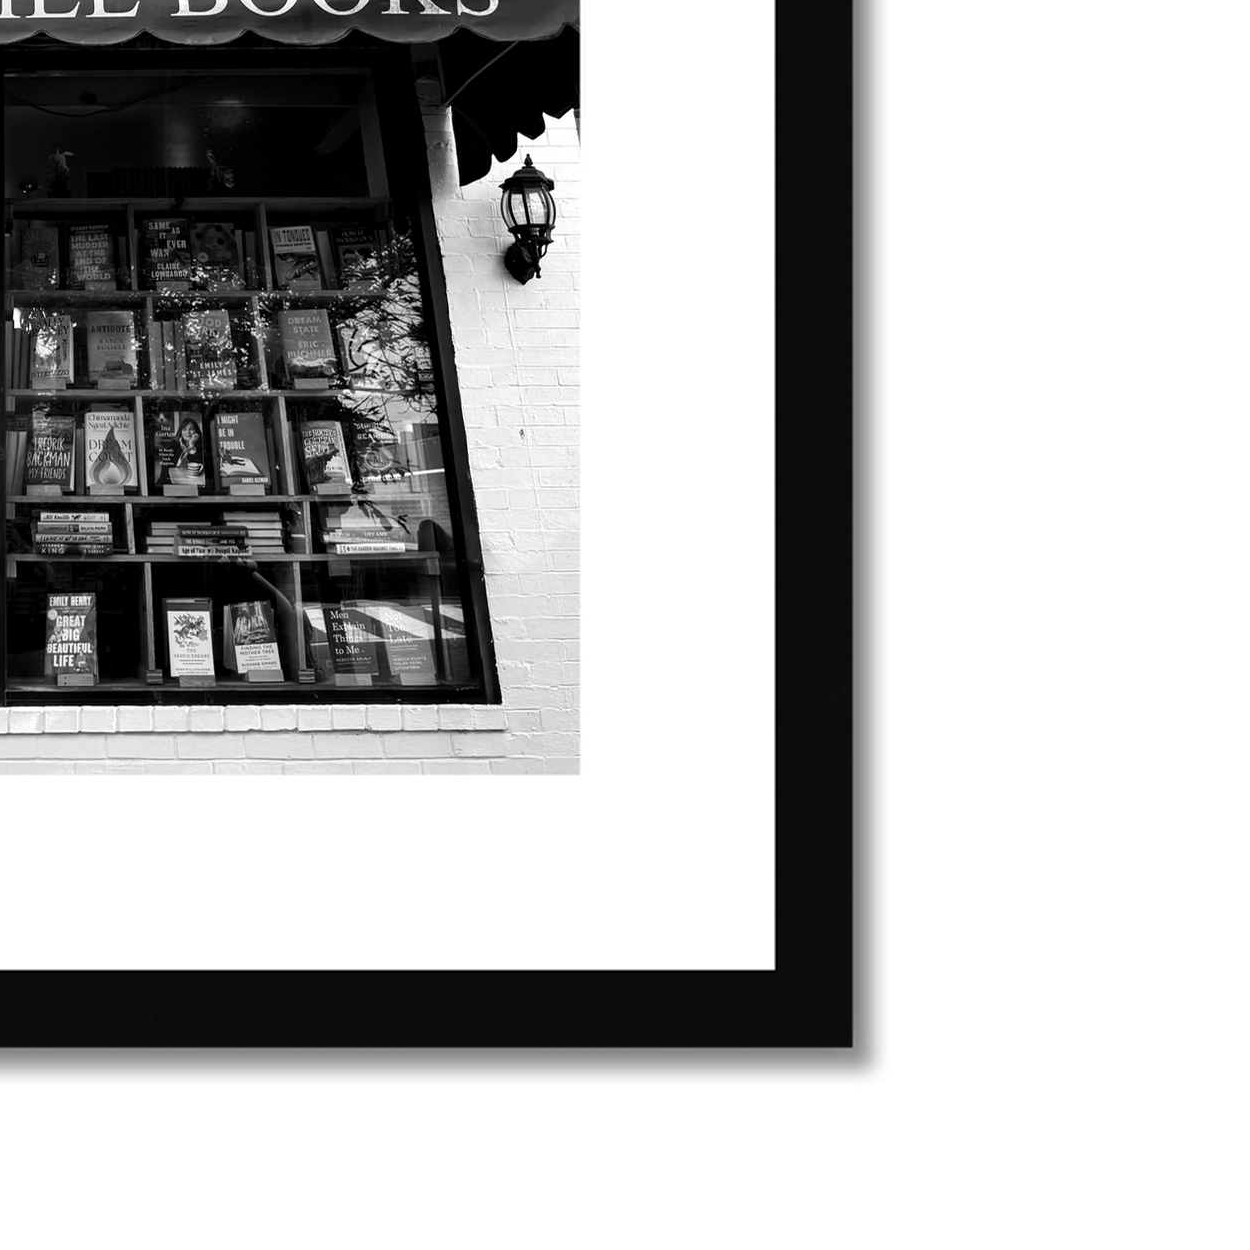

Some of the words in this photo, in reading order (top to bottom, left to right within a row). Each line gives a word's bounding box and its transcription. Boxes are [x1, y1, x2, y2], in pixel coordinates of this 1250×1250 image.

[149, 221, 170, 230] SAME
[171, 227, 181, 235] AS
[274, 230, 282, 243] IN
[283, 228, 311, 243] TONGUES
[88, 233, 109, 242] LAST
[159, 232, 167, 240] IT
[71, 241, 109, 250] MURDER
[166, 240, 187, 249] EVER
[75, 250, 88, 258] AT
[150, 249, 170, 258] WAS
[75, 258, 93, 266] END
[94, 257, 108, 265] OF
[76, 273, 111, 281] WORLD
[287, 316, 322, 325] DREAM
[90, 325, 131, 334] ANTIDOTE
[293, 326, 319, 334] STATE
[298, 340, 319, 349] ERIC
[287, 350, 333, 360] PUCHNER
[199, 361, 223, 370] EMILY
[221, 415, 239, 424] MIGHT
[218, 429, 227, 437] BE
[228, 429, 235, 437] IN
[34, 436, 65, 451] FREDRIK
[88, 440, 132, 451] DREAM
[220, 441, 246, 450] TROUBLE
[26, 451, 71, 468] BACKMAN
[88, 451, 133, 463] COUNT
[28, 468, 39, 480] MY
[40, 467, 67, 480] FRIENDS
[41, 547, 65, 555] KING
[182, 547, 190, 555] Age
[49, 596, 69, 607] EMILY
[70, 596, 92, 607] HENRY
[330, 611, 349, 620] Men
[384, 611, 404, 622] Not
[56, 615, 87, 628] GREAT
[332, 621, 366, 632] Explain
[62, 629, 81, 642] BIG
[333, 634, 364, 644] Things
[387, 634, 413, 645] Late
[46, 642, 93, 654] BEAUTIFUL
[335, 646, 345, 655] to
[346, 645, 360, 655] Me
[53, 654, 75, 668] LIFE
